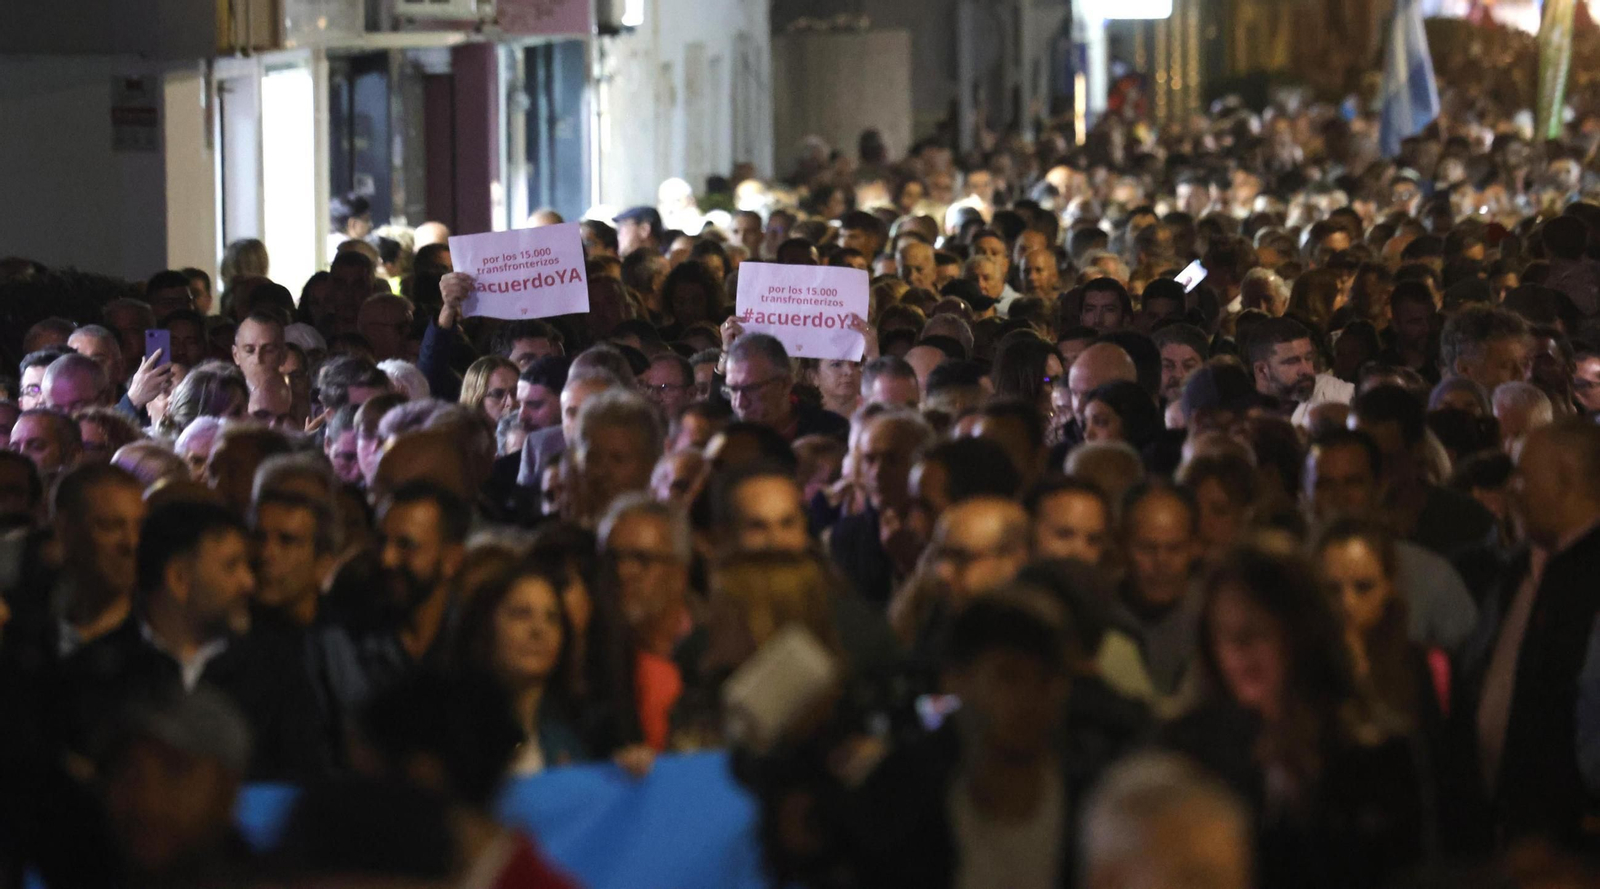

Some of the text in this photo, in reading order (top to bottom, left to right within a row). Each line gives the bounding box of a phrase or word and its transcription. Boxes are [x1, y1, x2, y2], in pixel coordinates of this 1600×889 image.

[477, 256, 560, 275] transfronterizos
[482, 247, 552, 266] por los 15.000
[470, 267, 582, 293] acuerdoYA
[768, 285, 838, 297] por los 15.000
[761, 294, 844, 308] transfronterizos
